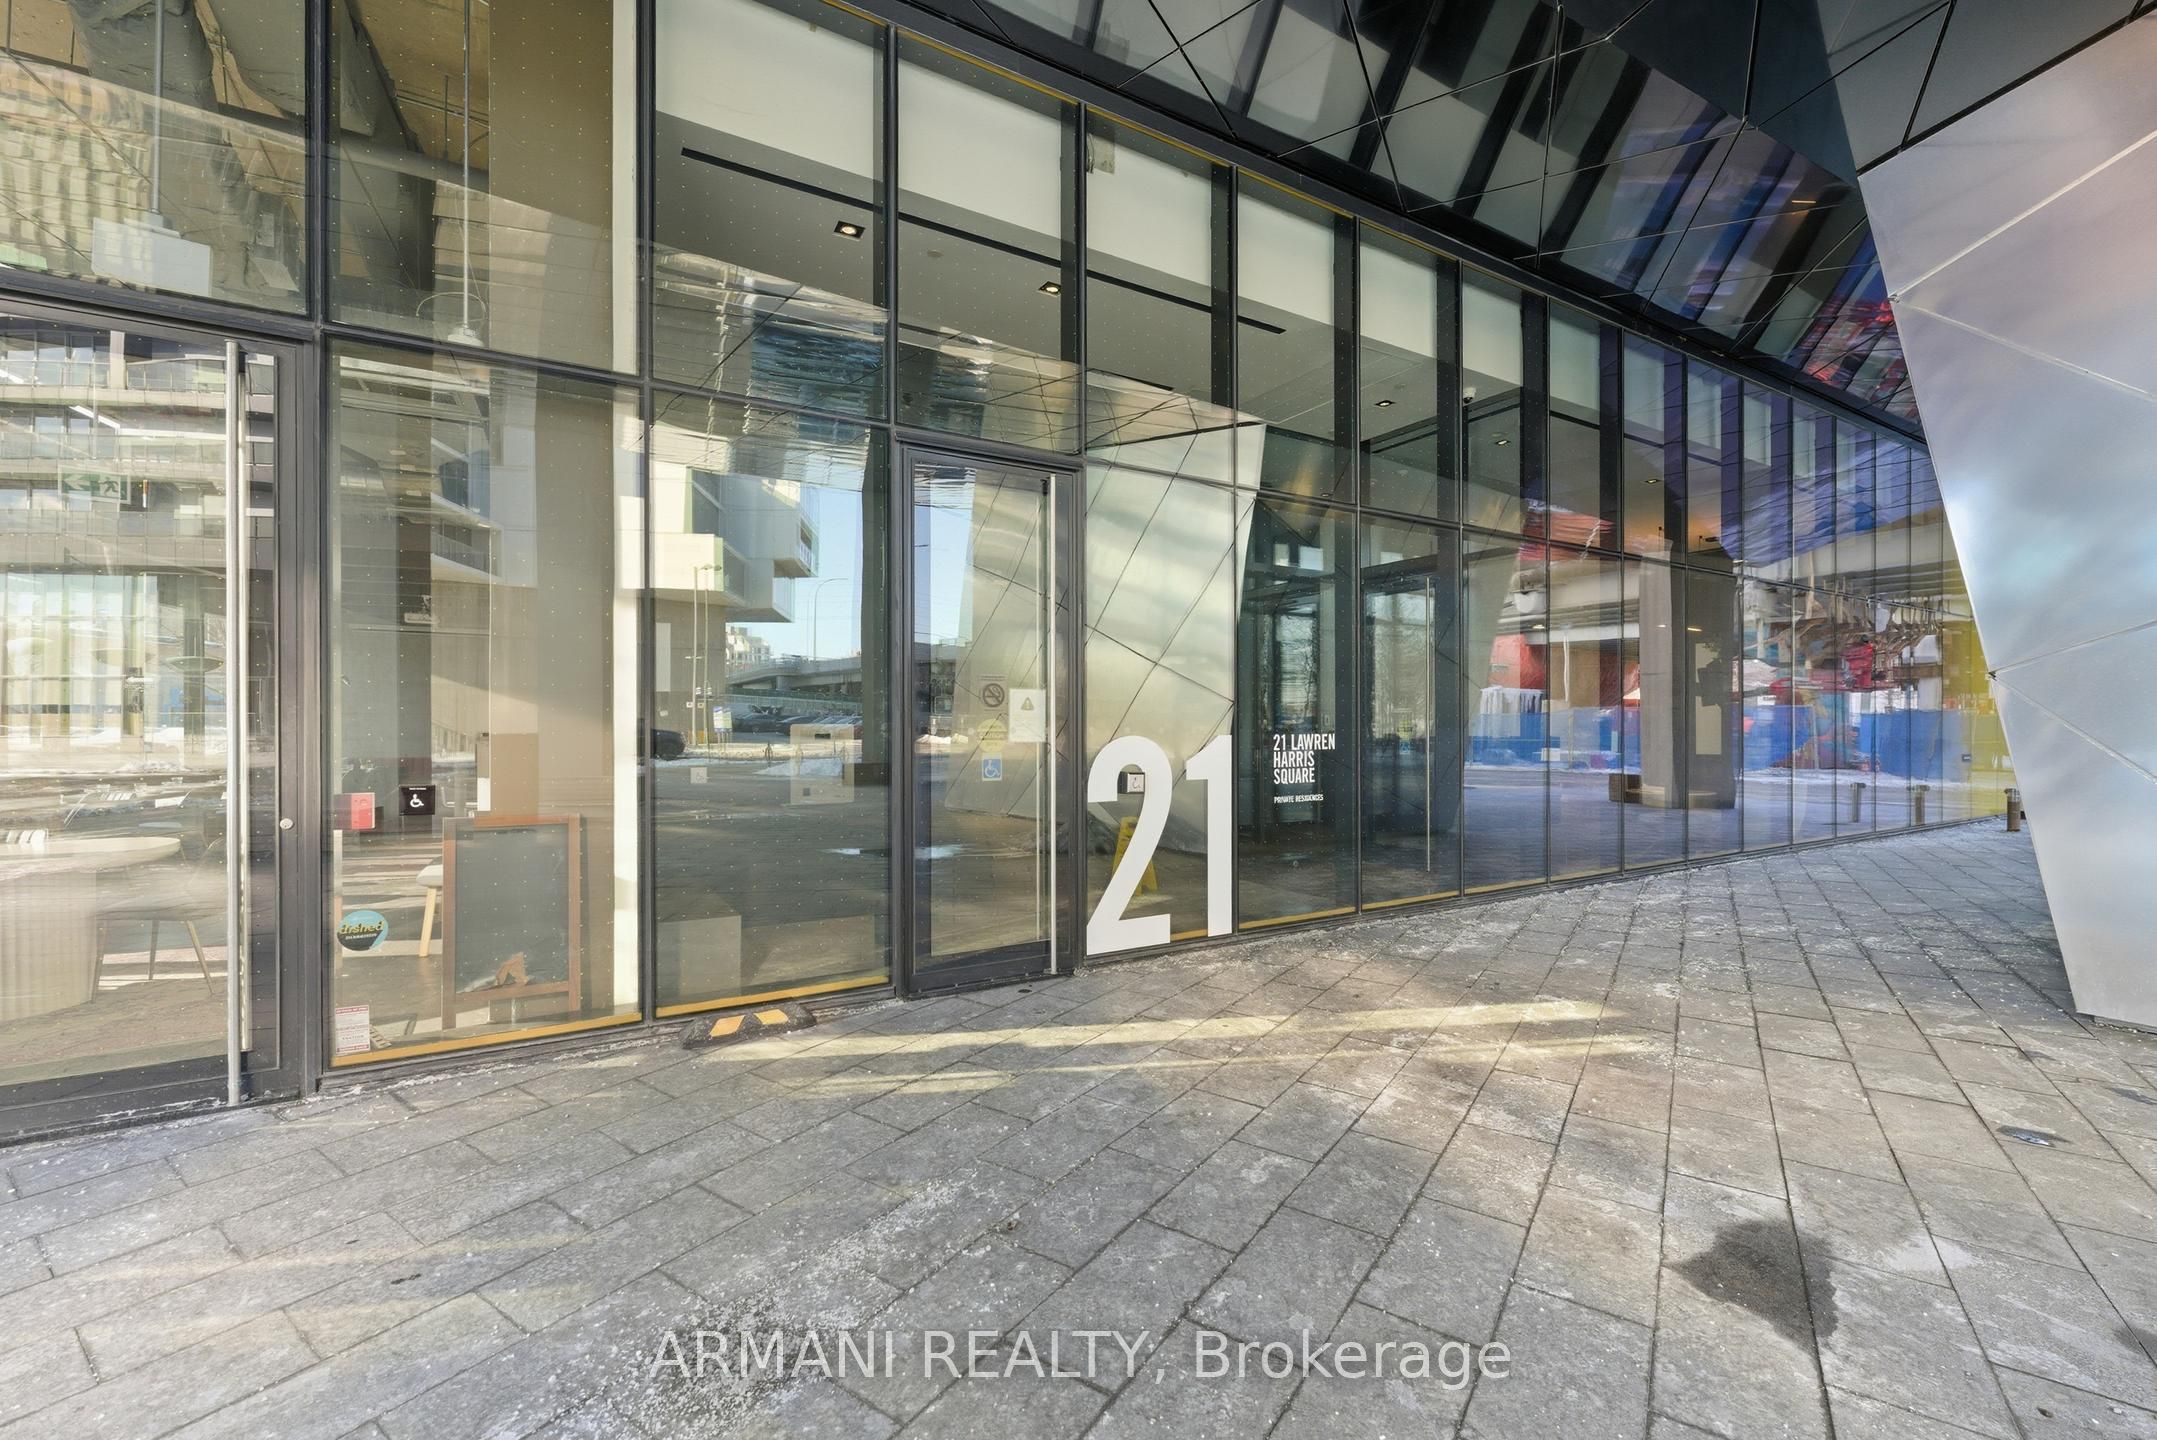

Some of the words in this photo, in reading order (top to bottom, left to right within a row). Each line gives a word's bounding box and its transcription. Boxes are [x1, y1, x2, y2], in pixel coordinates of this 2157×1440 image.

[1273, 734, 1286, 751] 21
[1291, 733, 1336, 751] LAWREN
[1273, 750, 1315, 768] HARRIS
[1273, 767, 1316, 785] SQUARE
[1086, 735, 1233, 956] 21
